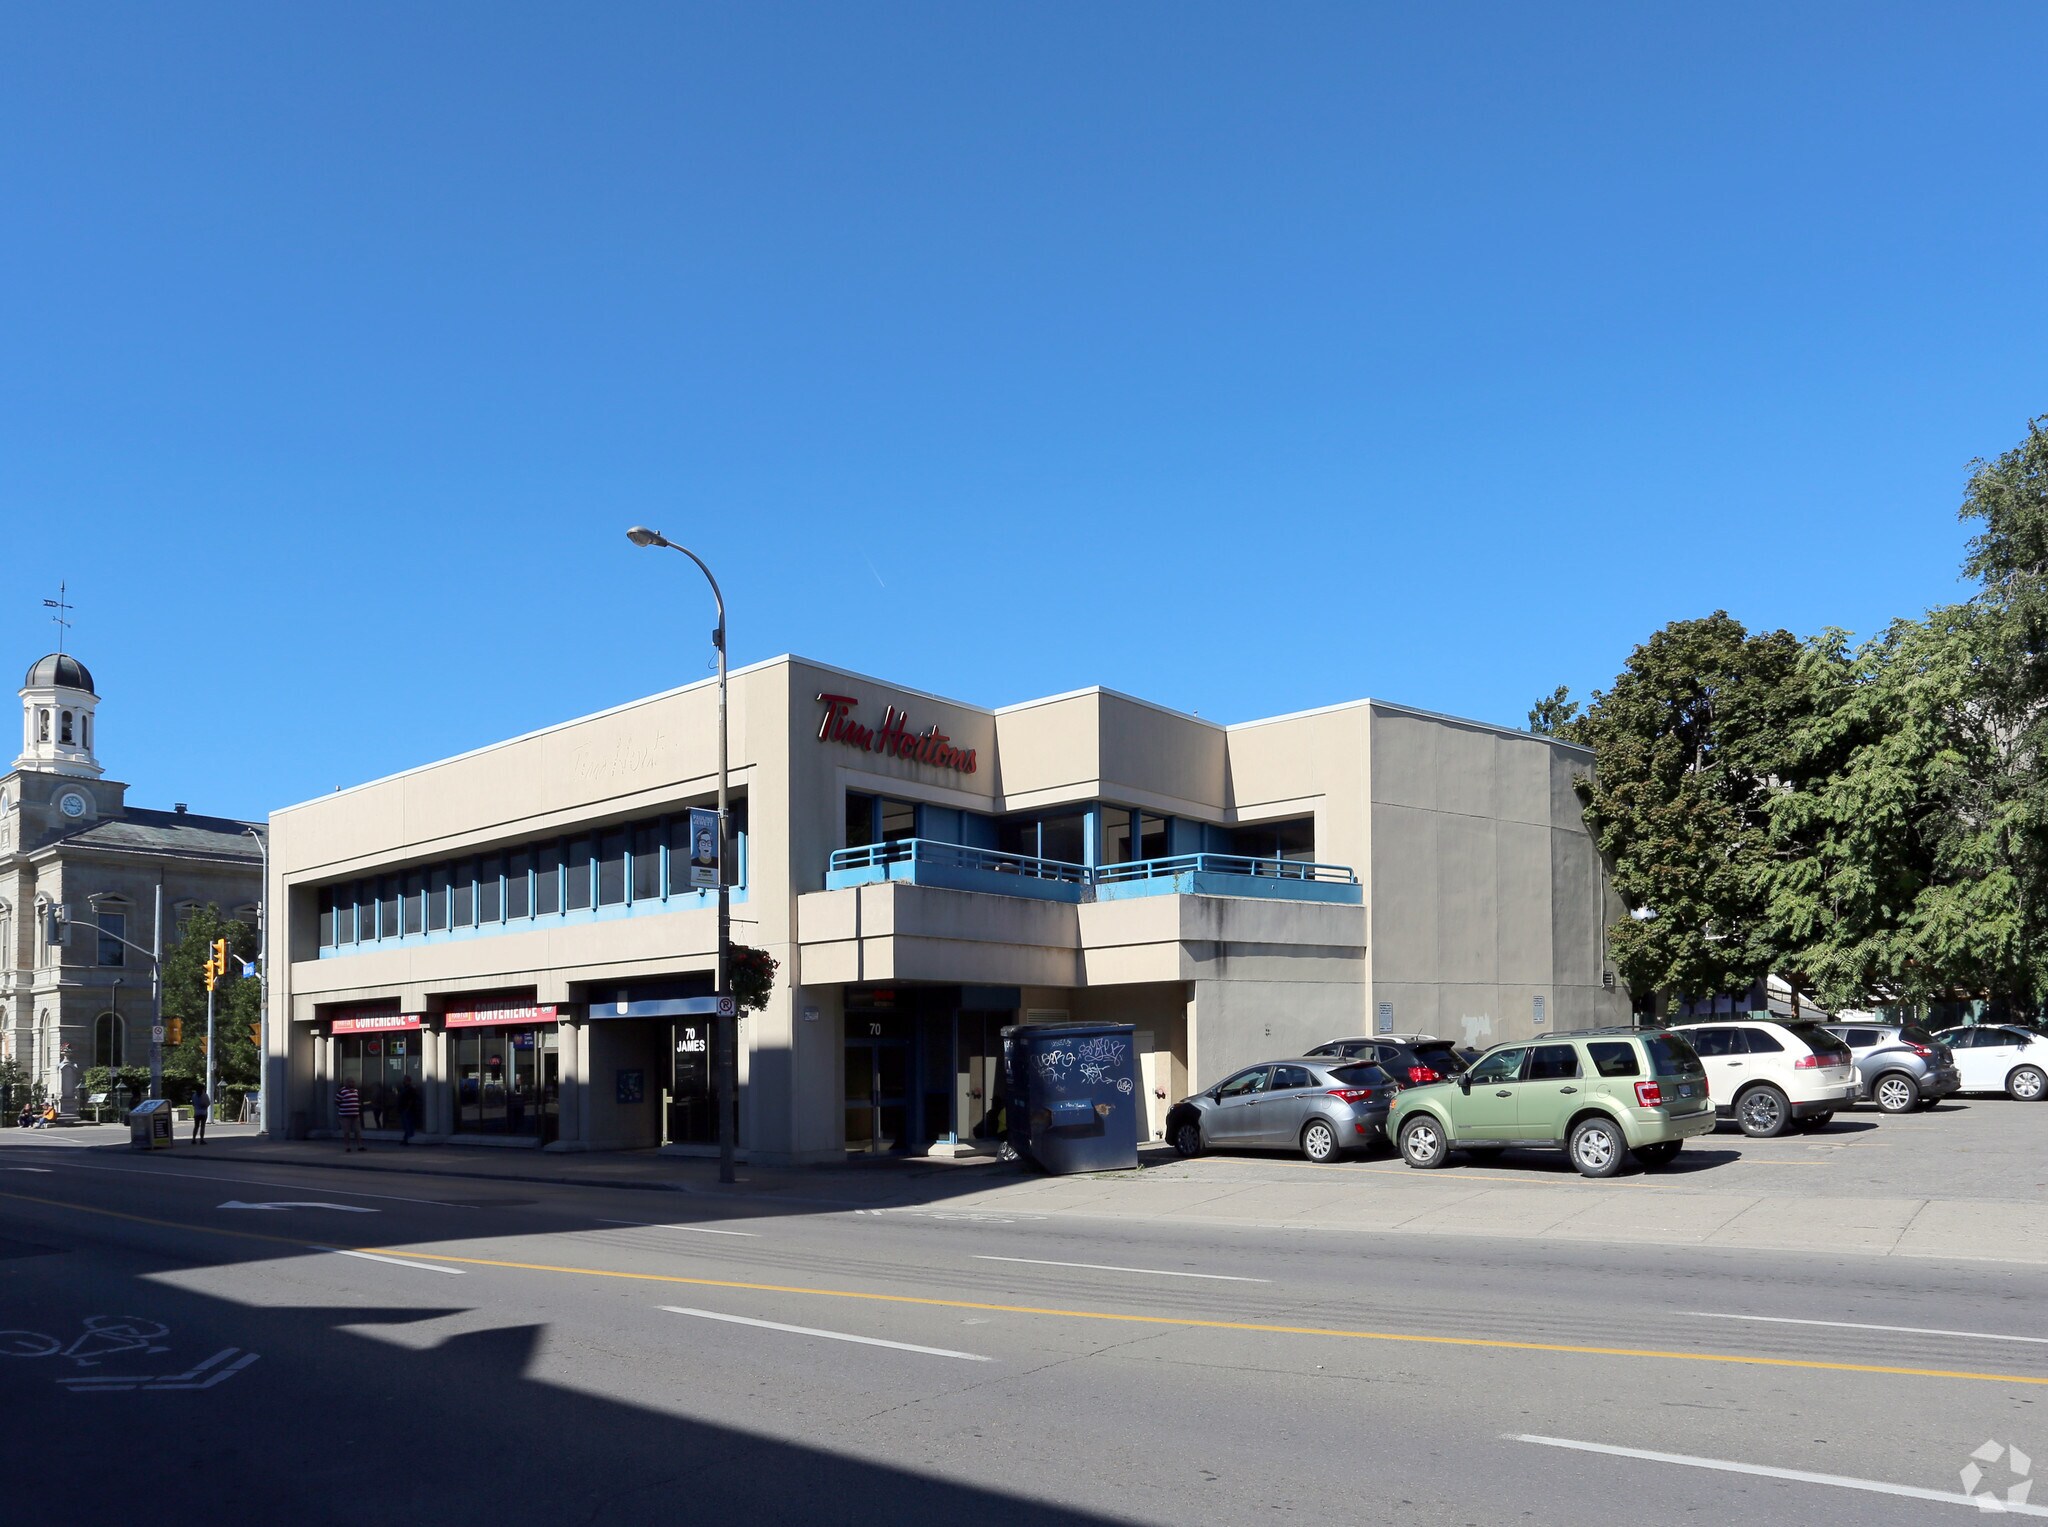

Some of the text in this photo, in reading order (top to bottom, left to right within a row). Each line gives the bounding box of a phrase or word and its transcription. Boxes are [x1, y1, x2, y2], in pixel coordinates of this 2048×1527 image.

[817, 693, 977, 774] Tim Hortons
[355, 1009, 406, 1029] CONVENIENCE
[474, 999, 537, 1022] CONVENIENCE
[685, 1027, 696, 1040] 70
[869, 1022, 881, 1036] 70
[676, 1039, 706, 1053] JAMES
